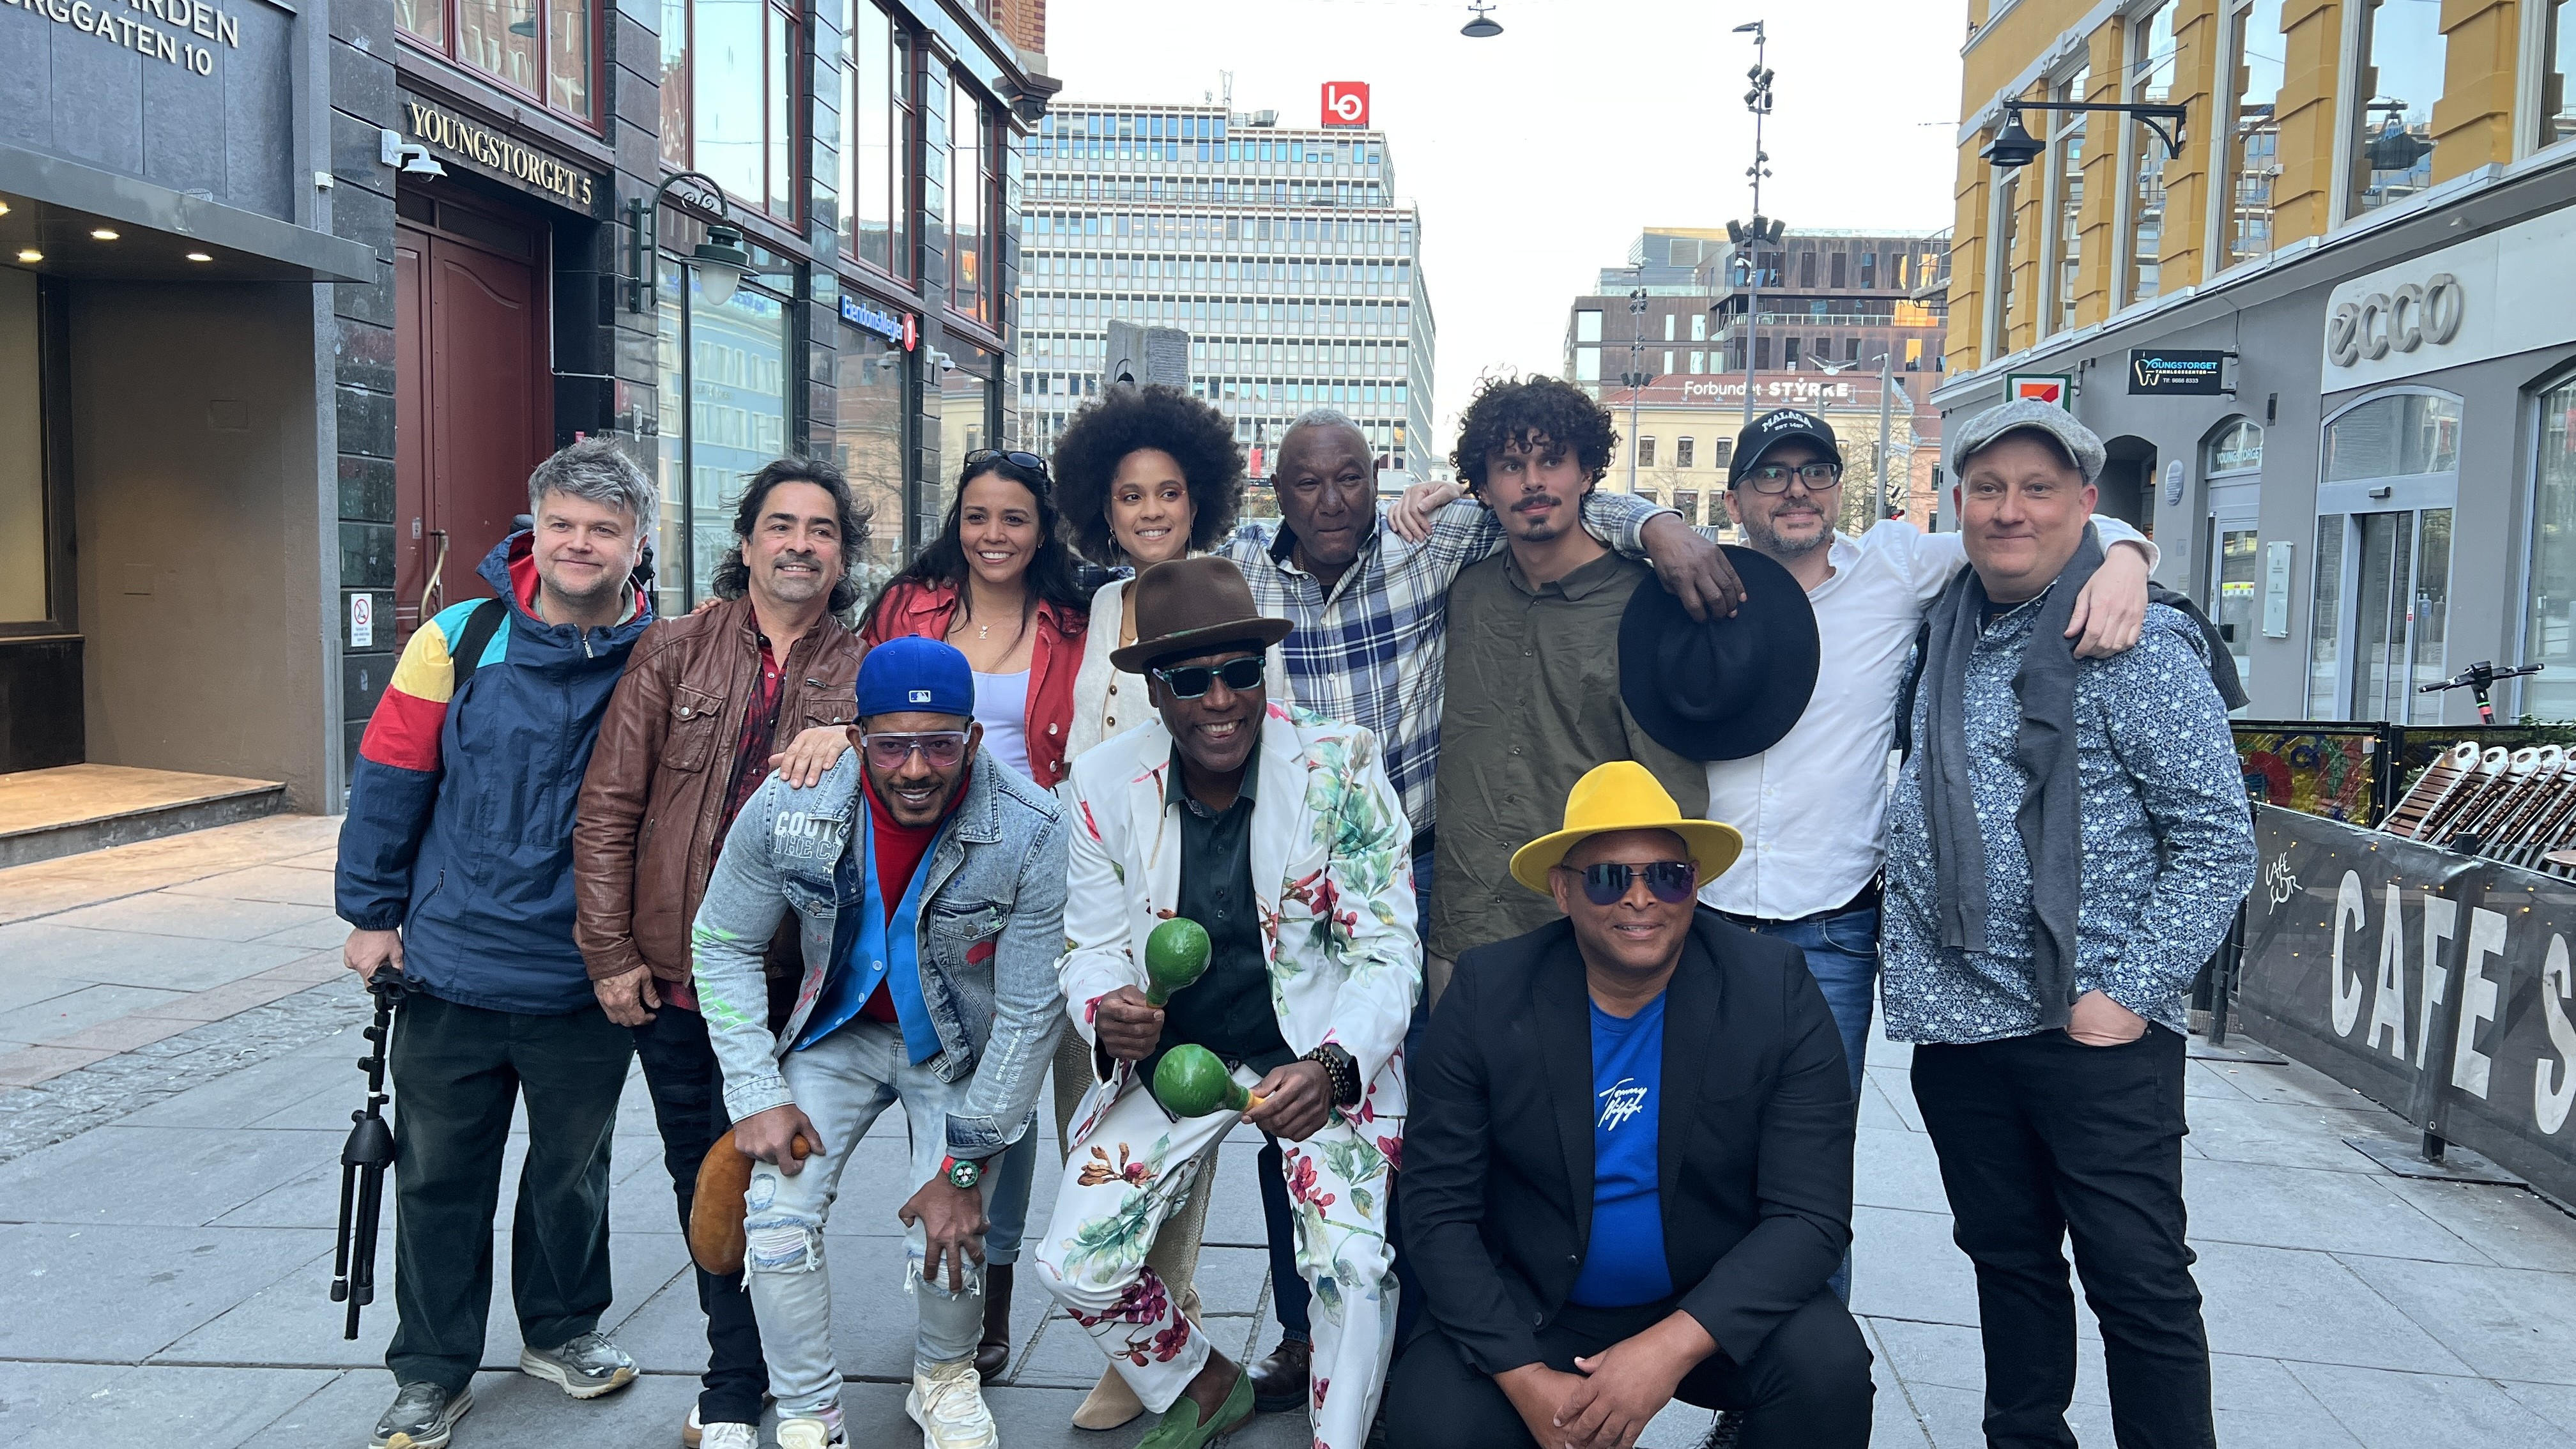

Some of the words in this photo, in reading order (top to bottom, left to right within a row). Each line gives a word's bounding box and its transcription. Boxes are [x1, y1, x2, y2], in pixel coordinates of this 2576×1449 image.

[185, 43, 212, 76] 10
[410, 102, 577, 199] YOUNGSTORGET
[582, 178, 592, 205] 5
[2140, 357, 2218, 370] YOUNGSTORGET
[1685, 381, 1761, 395] Forbundt
[2216, 447, 2263, 464] YOUNGSTORGET
[774, 833, 815, 859] THE
[2331, 869, 2508, 1101] CAFE
